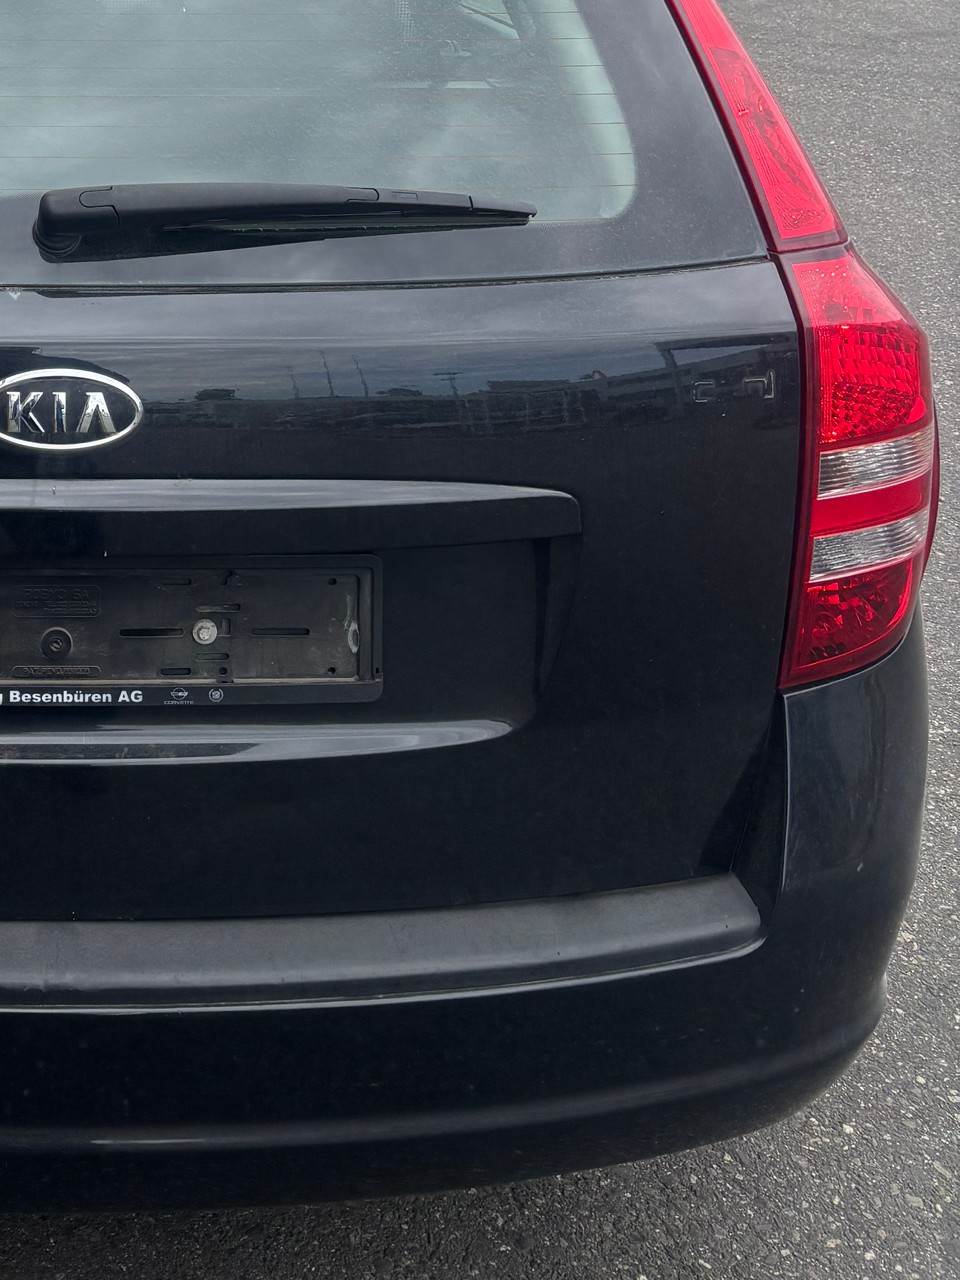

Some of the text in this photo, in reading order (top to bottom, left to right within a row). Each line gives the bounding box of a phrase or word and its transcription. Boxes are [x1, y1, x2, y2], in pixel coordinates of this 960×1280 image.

[6, 391, 117, 433] KIA
[9, 690, 112, 703] Besenbüren
[117, 690, 143, 703] AG
